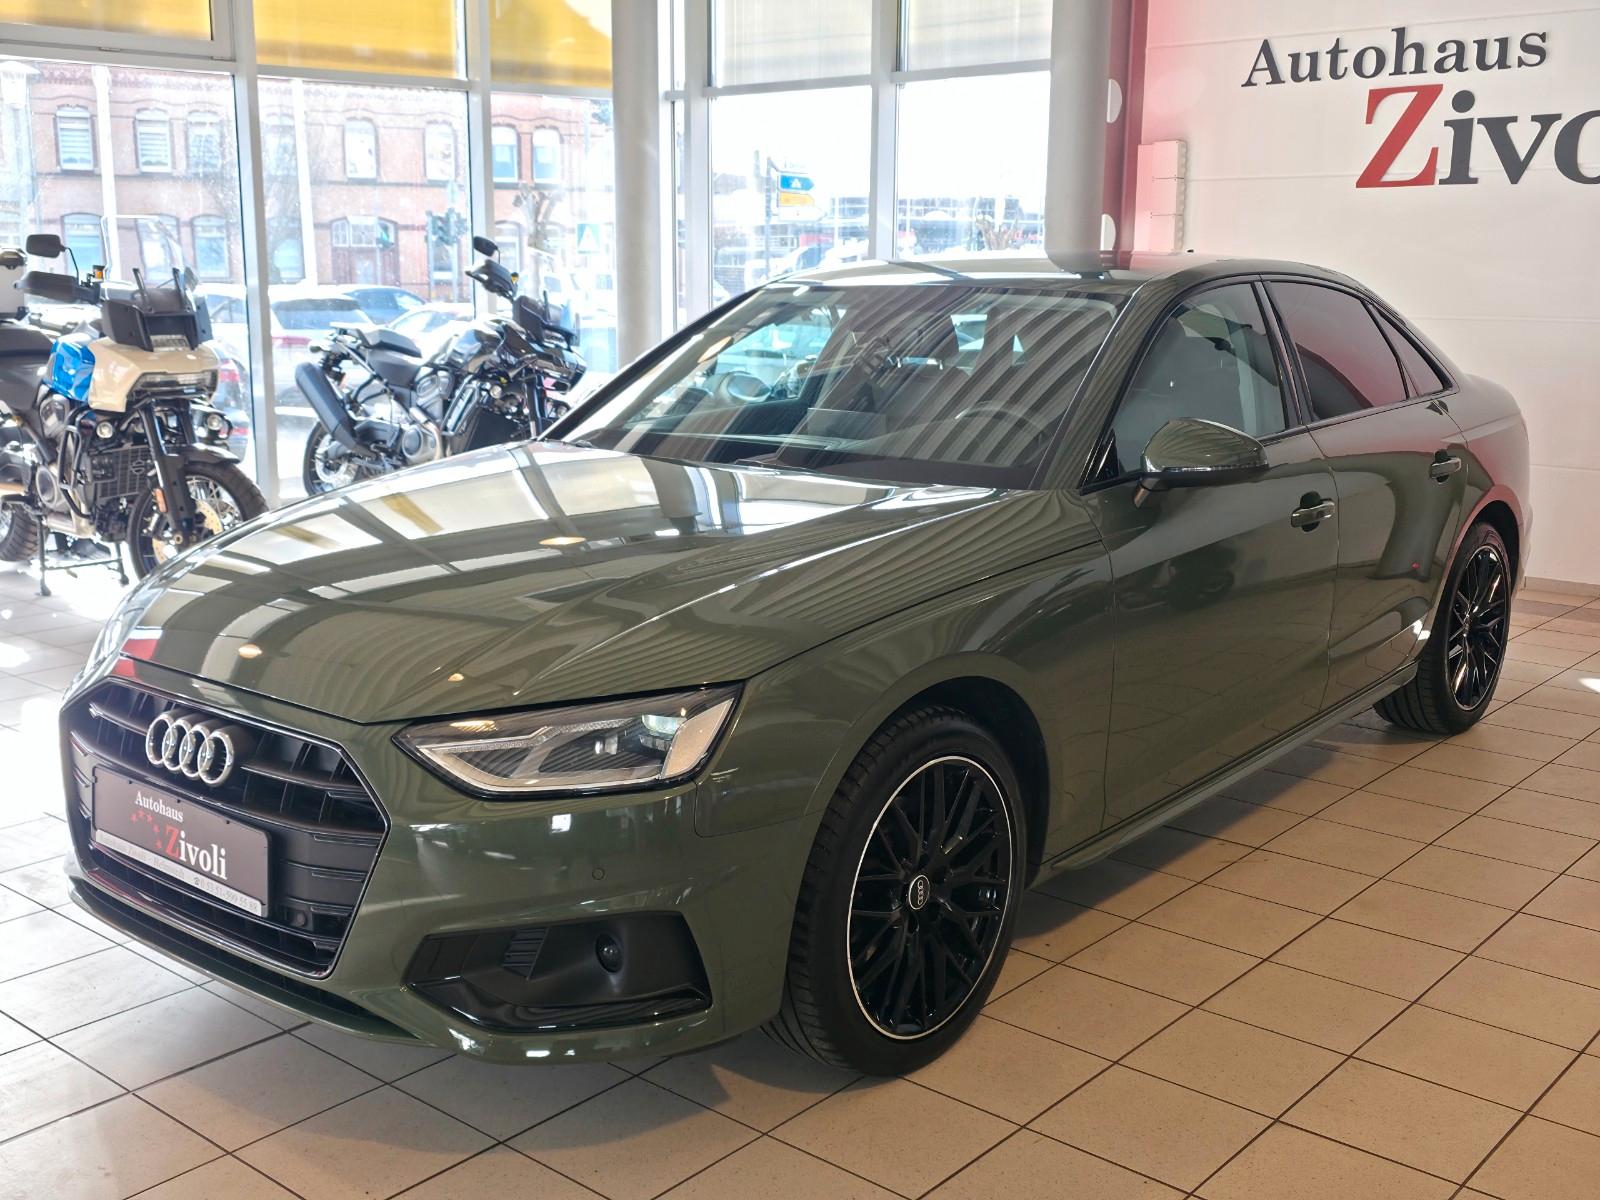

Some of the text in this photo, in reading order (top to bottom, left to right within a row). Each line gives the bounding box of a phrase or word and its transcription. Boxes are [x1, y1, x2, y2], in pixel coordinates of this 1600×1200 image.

[1241, 26, 1548, 87] Autohaus
[1355, 84, 1600, 188] Zivo
[134, 791, 184, 823] Autohaus
[165, 826, 228, 880] Zivoli
